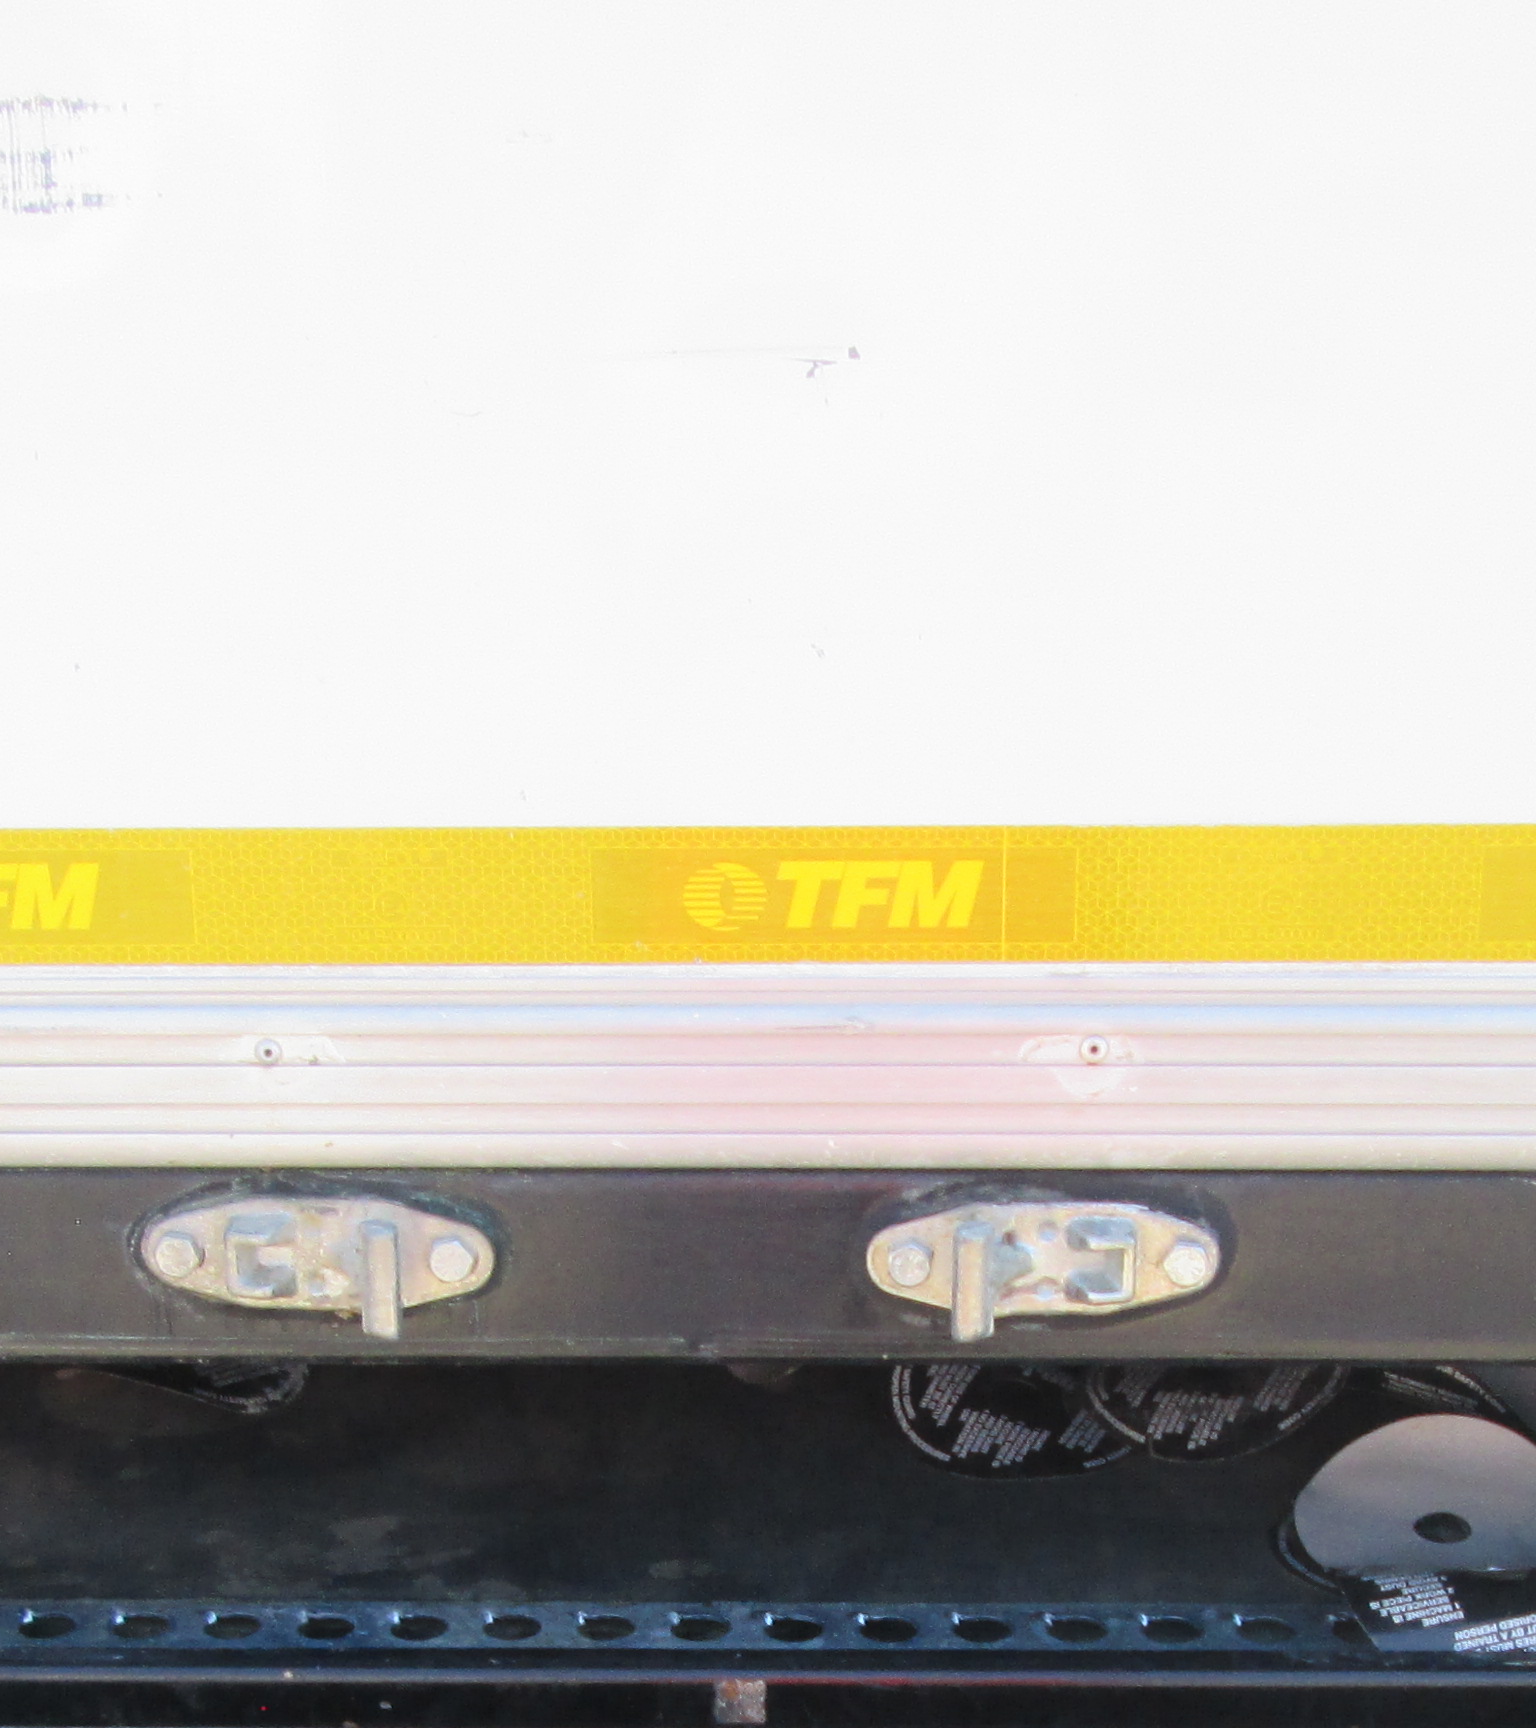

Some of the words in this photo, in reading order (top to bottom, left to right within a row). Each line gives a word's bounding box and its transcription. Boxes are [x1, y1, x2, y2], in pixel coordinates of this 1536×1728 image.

[776, 860, 985, 929] TFM
[1453, 1623, 1498, 1640] PERSON
[1499, 1630, 1508, 1640] A
[1509, 1627, 1525, 1638] BY
[1453, 1633, 1499, 1652] TRAINED
